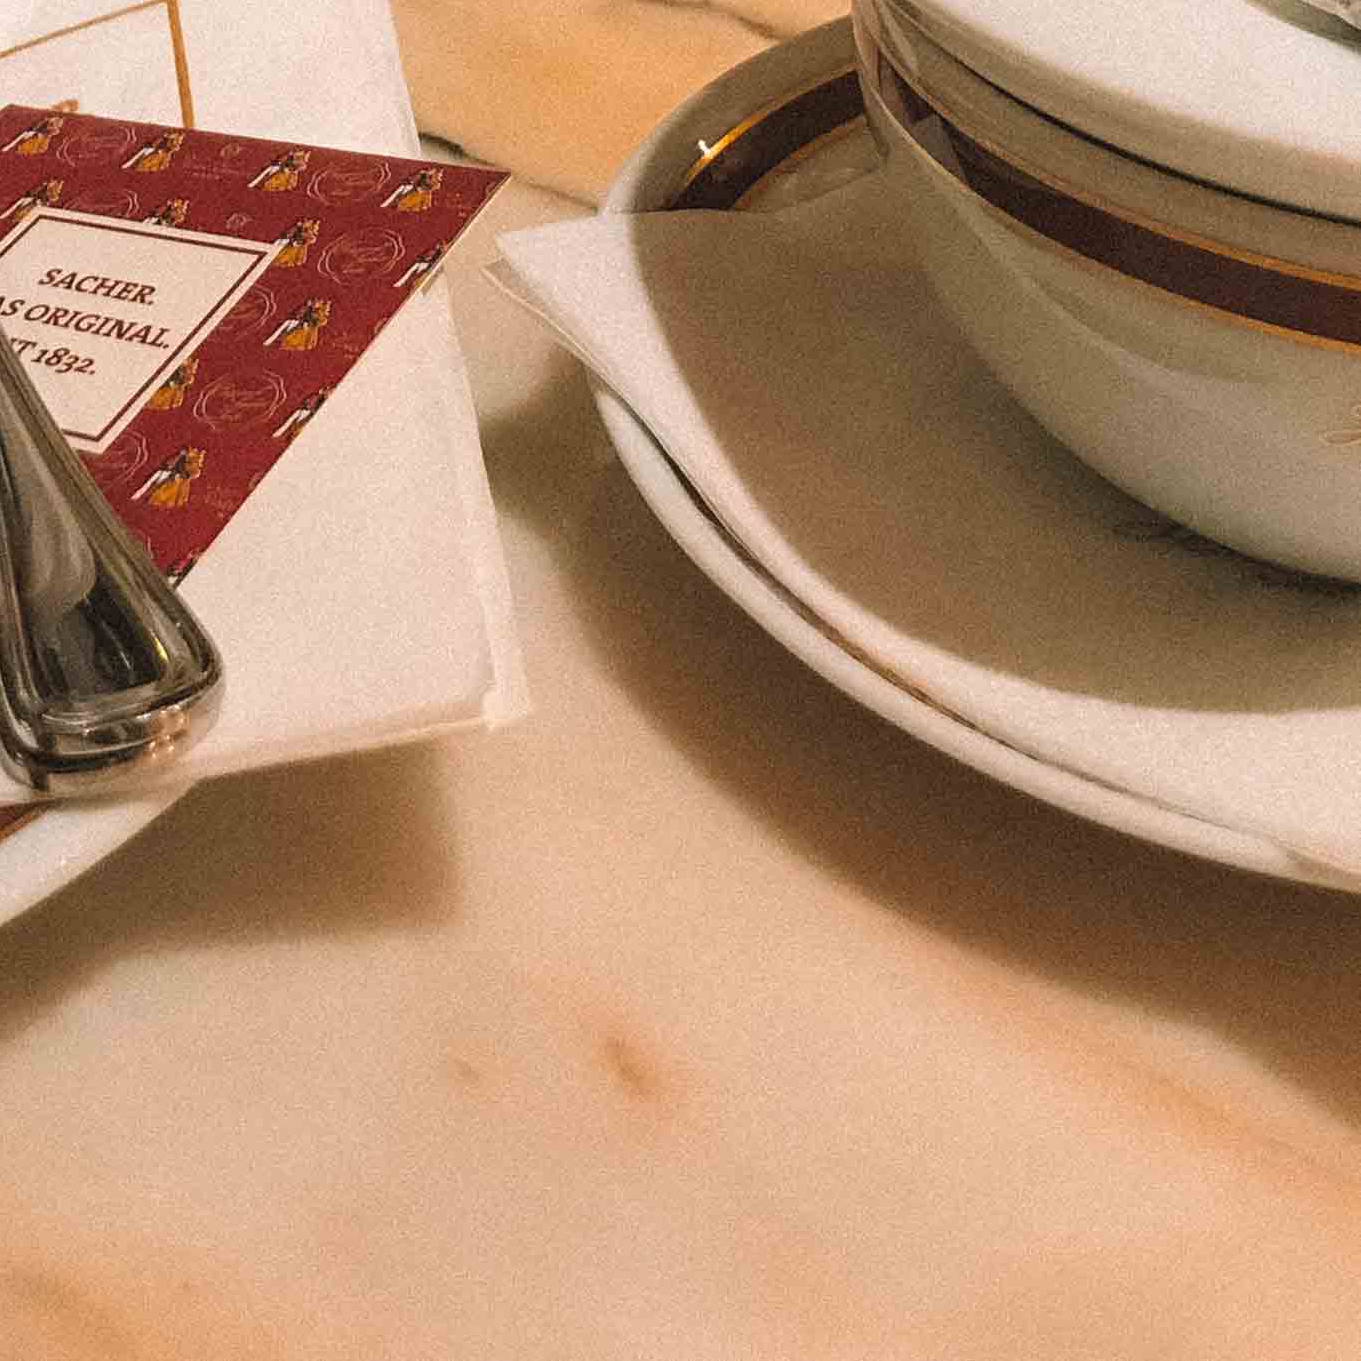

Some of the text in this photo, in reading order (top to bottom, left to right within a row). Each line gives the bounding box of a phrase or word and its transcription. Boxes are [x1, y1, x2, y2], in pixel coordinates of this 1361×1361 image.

[38, 267, 156, 305] SACHER.
[24, 303, 170, 349] ORIGINAL.
[31, 346, 96, 374] 1832.
